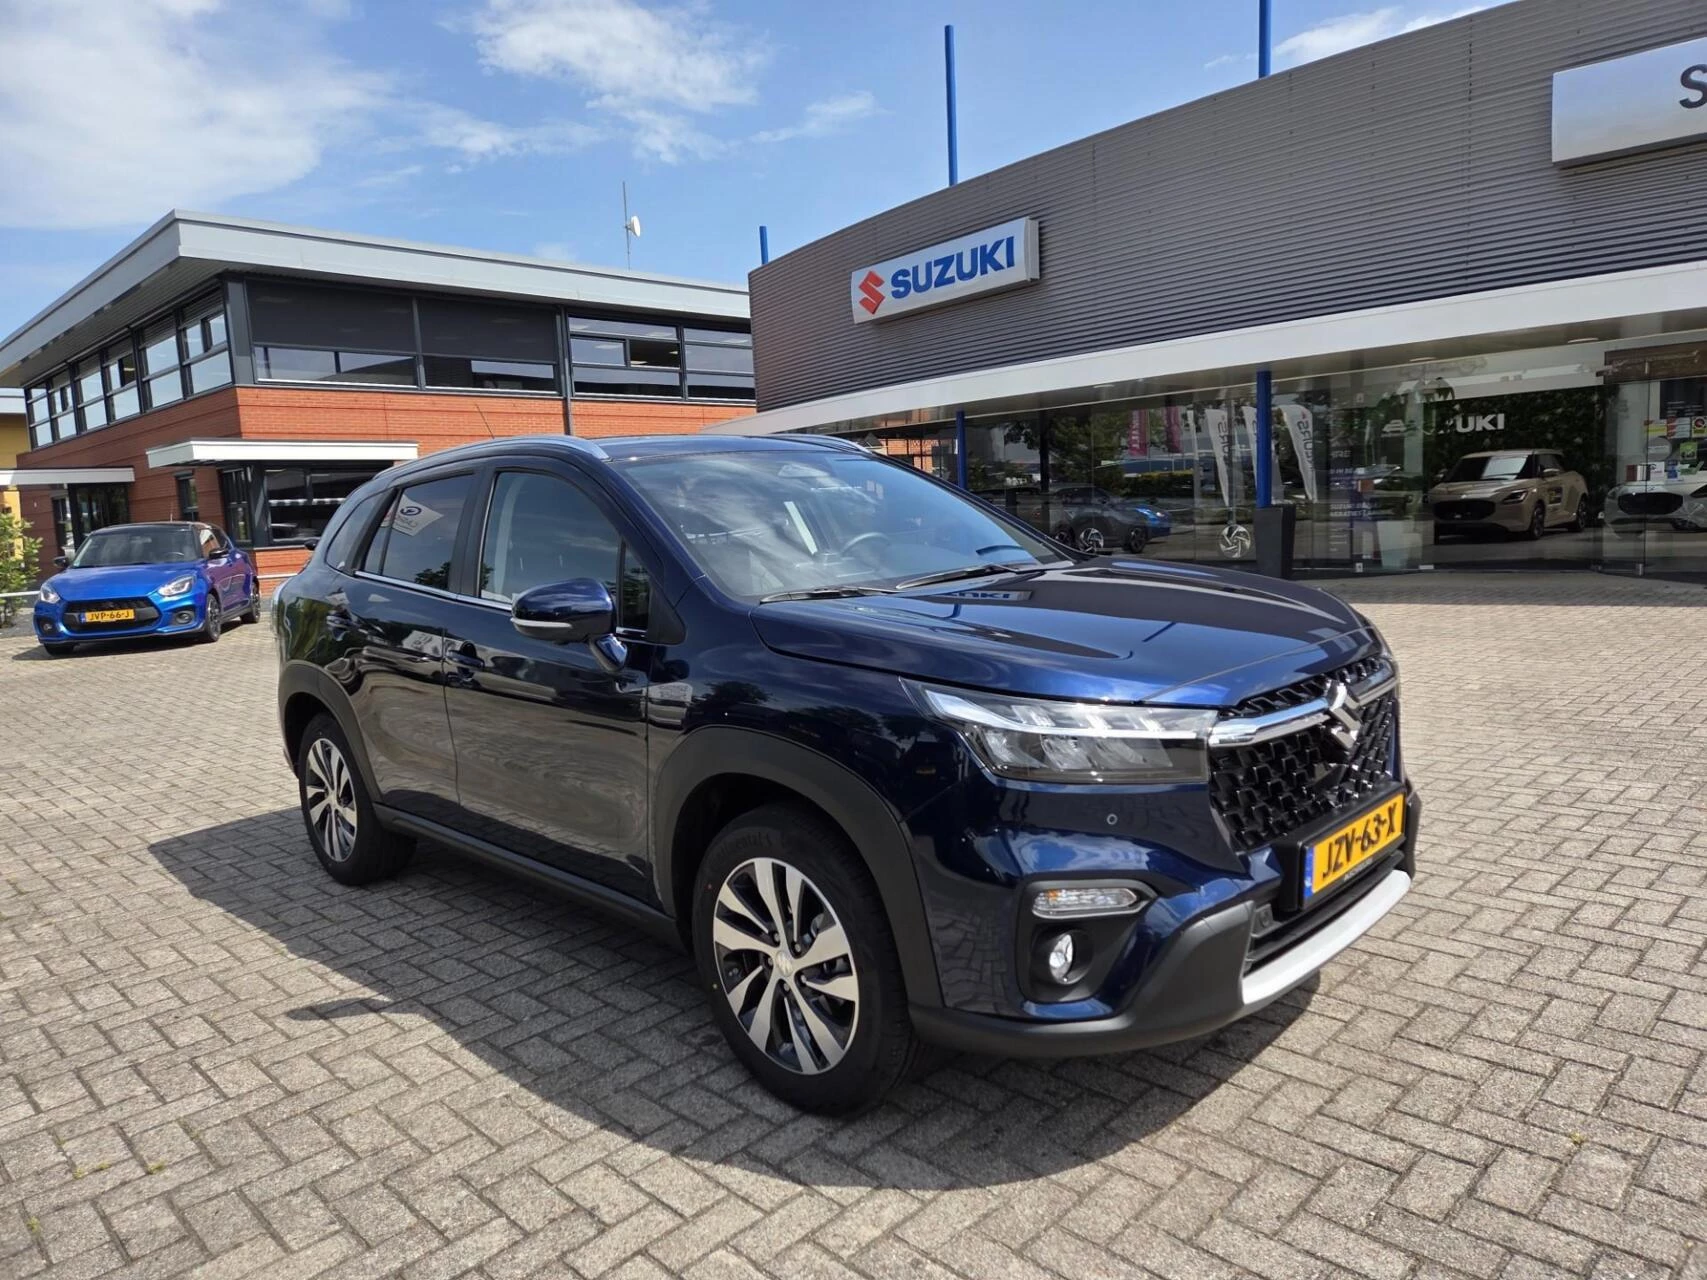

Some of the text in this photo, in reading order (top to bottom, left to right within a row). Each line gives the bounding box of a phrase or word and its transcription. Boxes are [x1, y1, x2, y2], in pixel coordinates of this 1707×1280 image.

[891, 236, 1015, 299] SUZUKI
[1438, 413, 1505, 433] UKI
[89, 610, 130, 621] JVP-66-J
[1322, 801, 1398, 879] JZV-63-X
